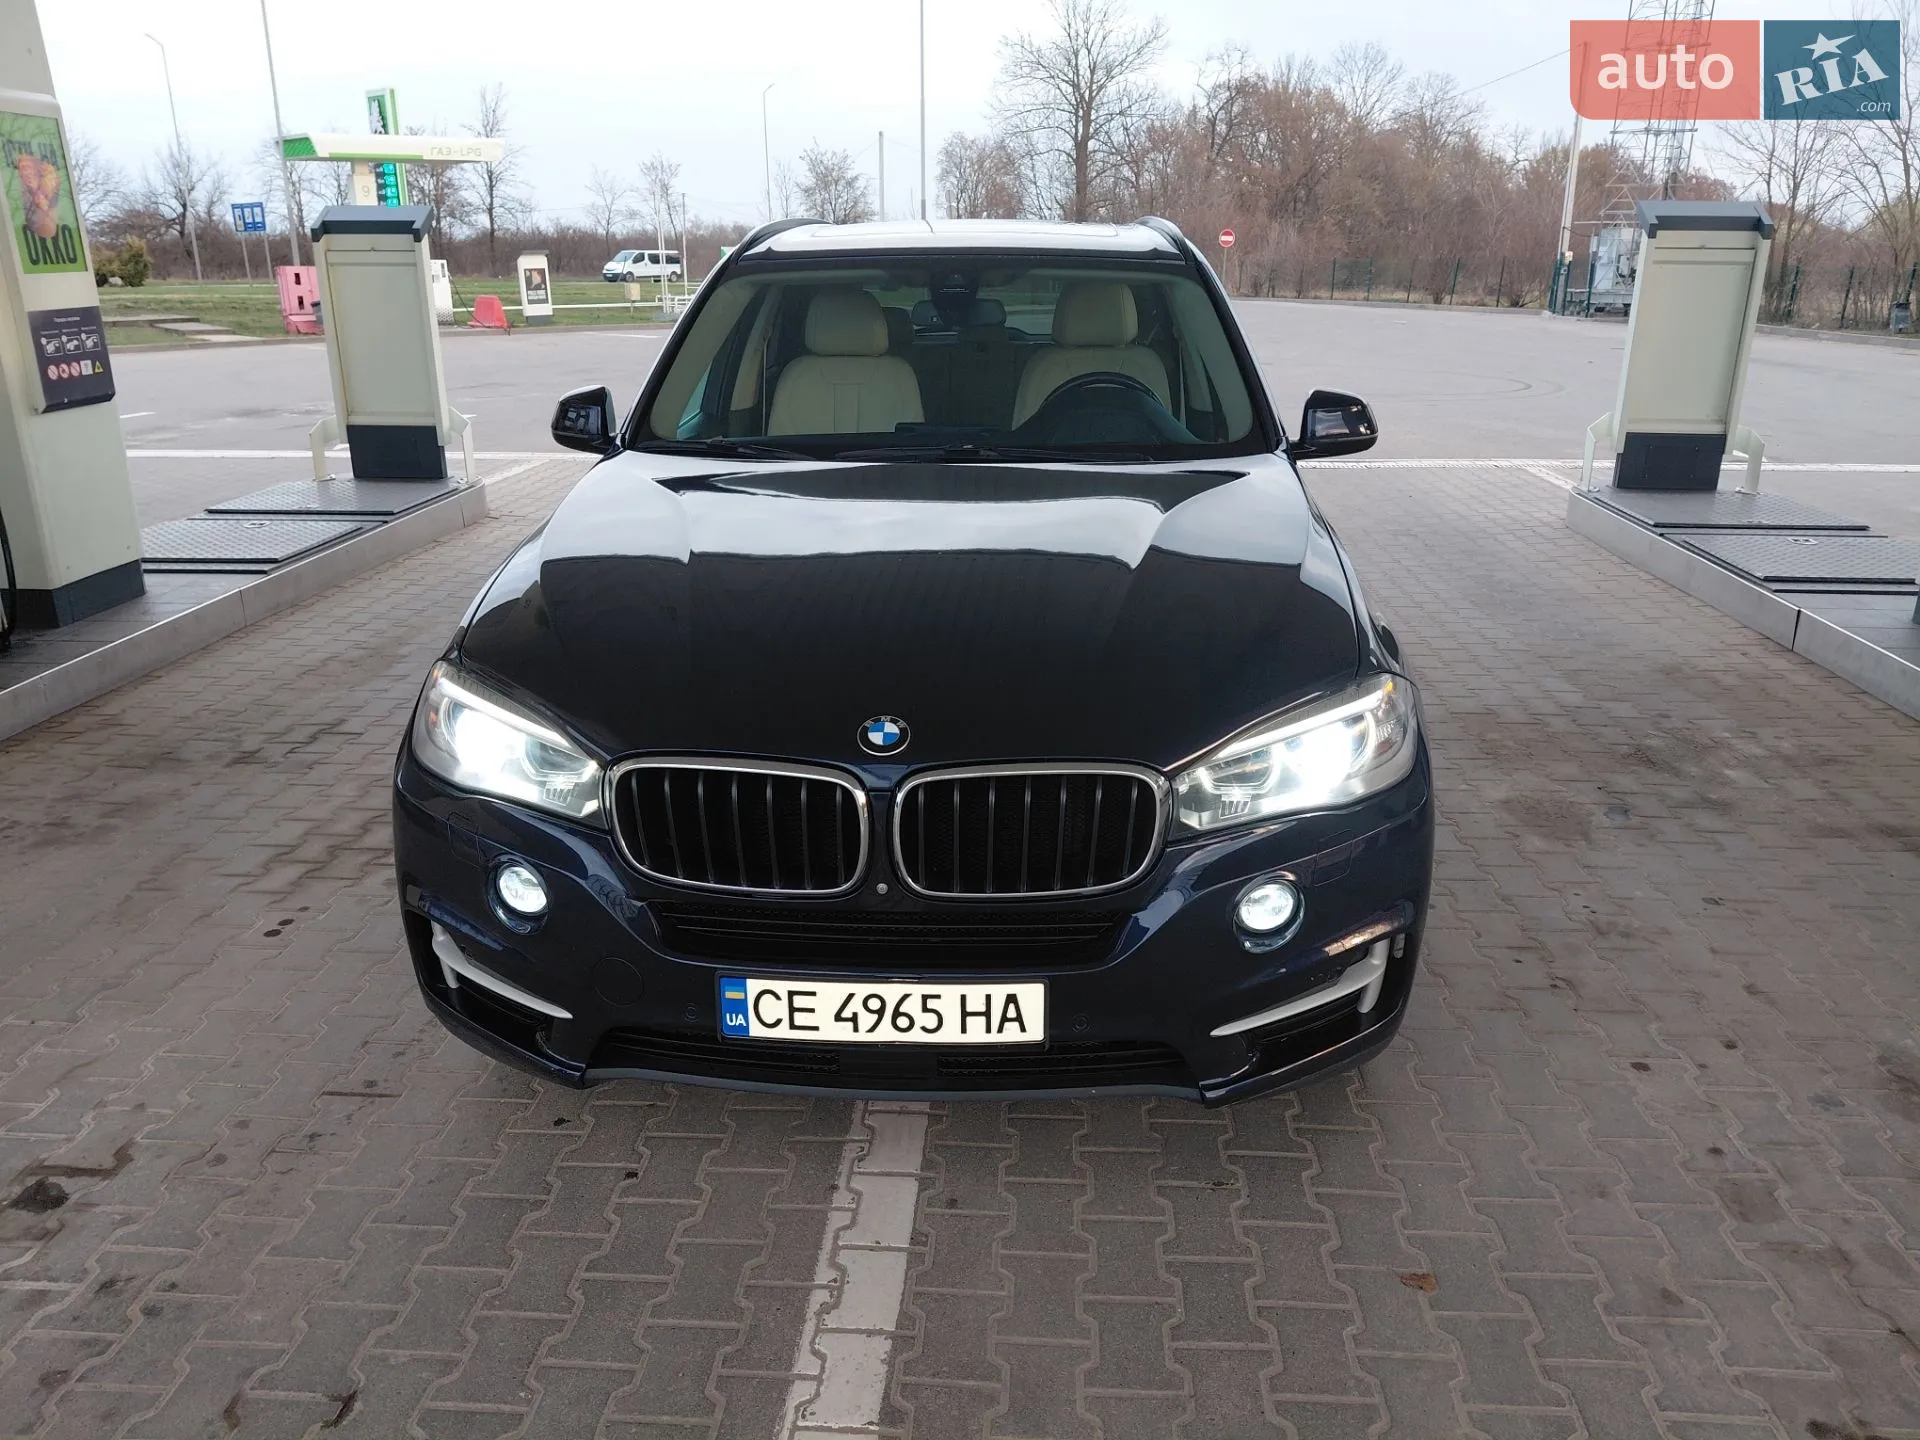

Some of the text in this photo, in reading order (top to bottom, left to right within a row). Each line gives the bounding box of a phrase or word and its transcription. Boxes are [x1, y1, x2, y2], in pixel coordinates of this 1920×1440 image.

[361, 185, 371, 198] 9
[753, 989, 1027, 1034] CE 4965 HA
[726, 1013, 747, 1027] UA
